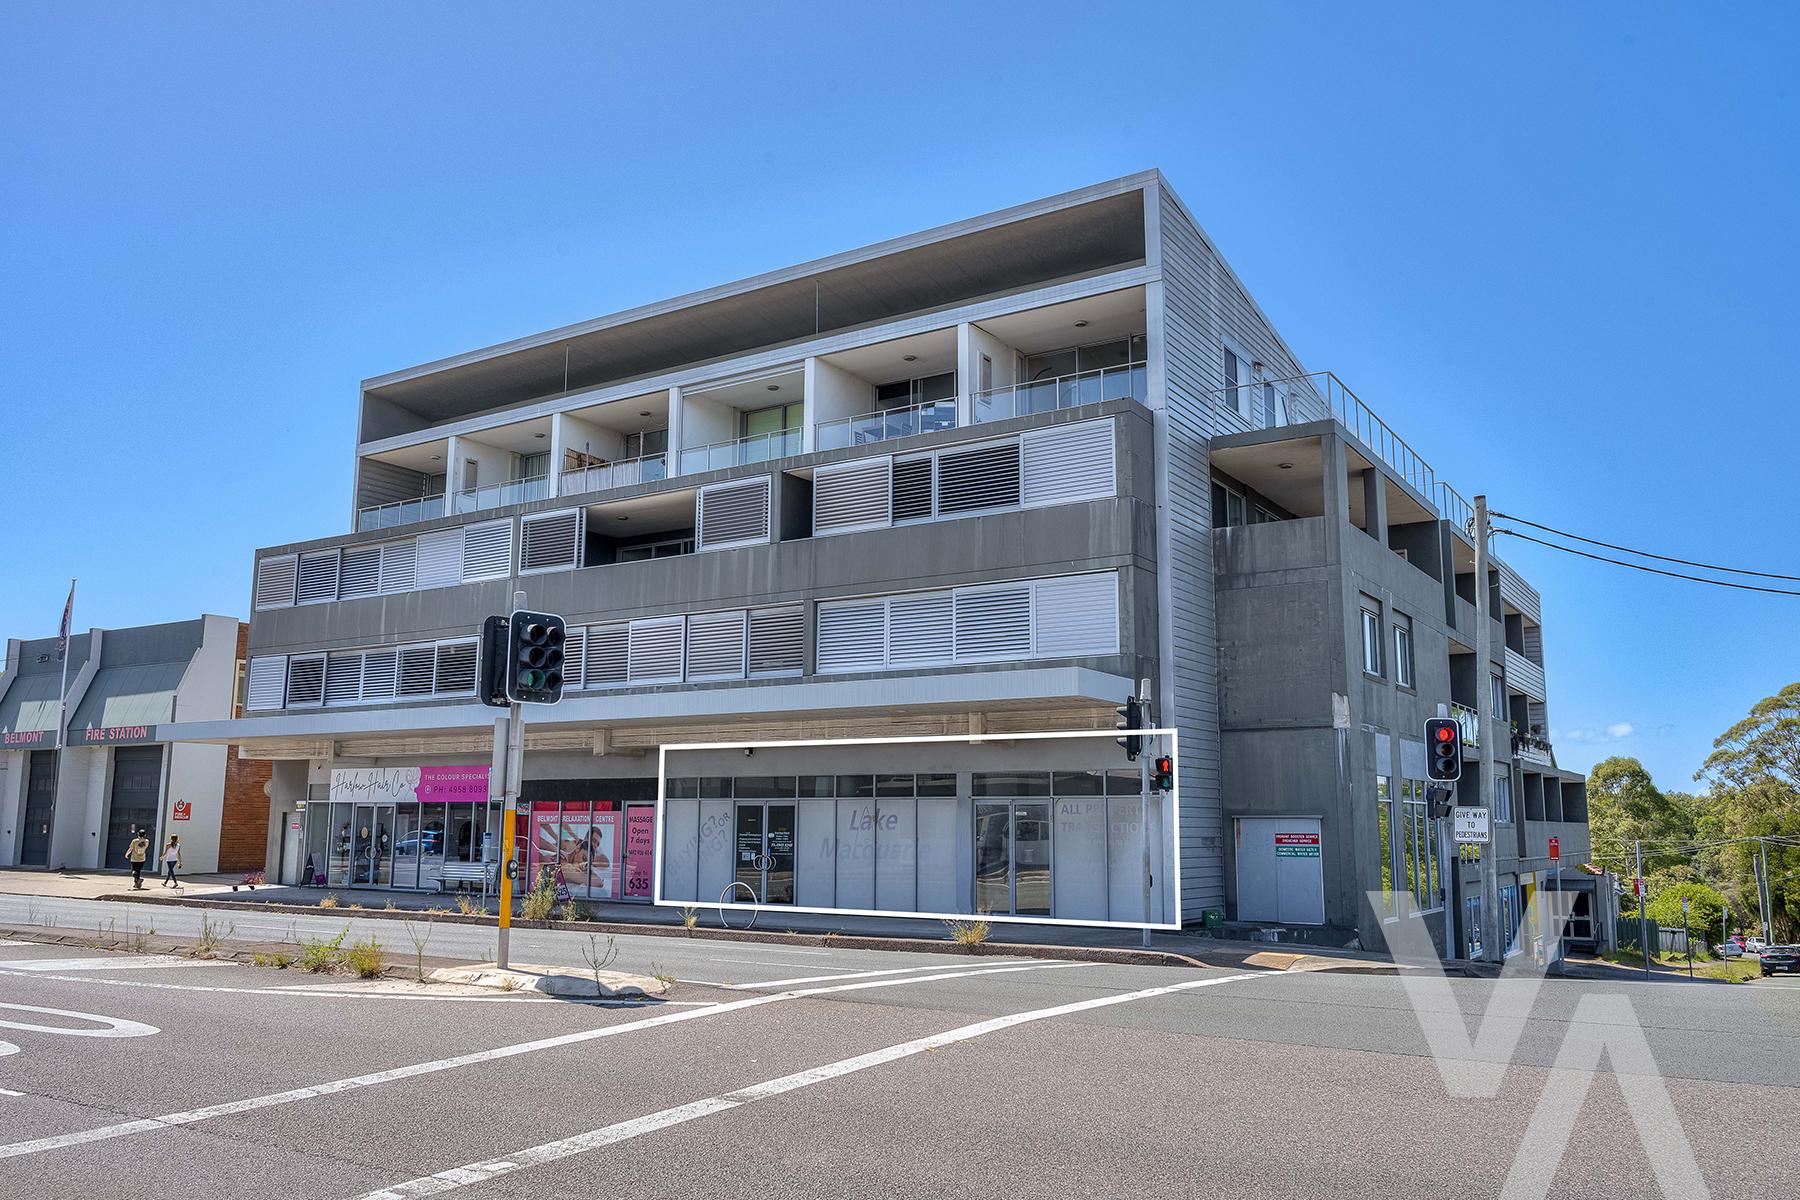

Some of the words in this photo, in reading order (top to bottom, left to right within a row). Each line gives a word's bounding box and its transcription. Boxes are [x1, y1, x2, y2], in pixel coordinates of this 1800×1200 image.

[4, 731, 44, 744] BELMONT
[85, 728, 105, 741] FIRE
[109, 726, 148, 740] STATION
[363, 770, 391, 800] Hair
[391, 769, 406, 797] Co
[1060, 803, 1082, 815] ALL
[1455, 811, 1470, 819] GIVE
[1472, 811, 1487, 819] WAY
[629, 816, 653, 824] MASSAGE
[718, 812, 731, 828] OR
[849, 807, 899, 831] Lake
[1467, 821, 1476, 829] TO
[632, 827, 649, 836] Open
[1455, 831, 1488, 839] PEDESTRIANS
[636, 837, 650, 846] days
[628, 878, 649, 890] 635
